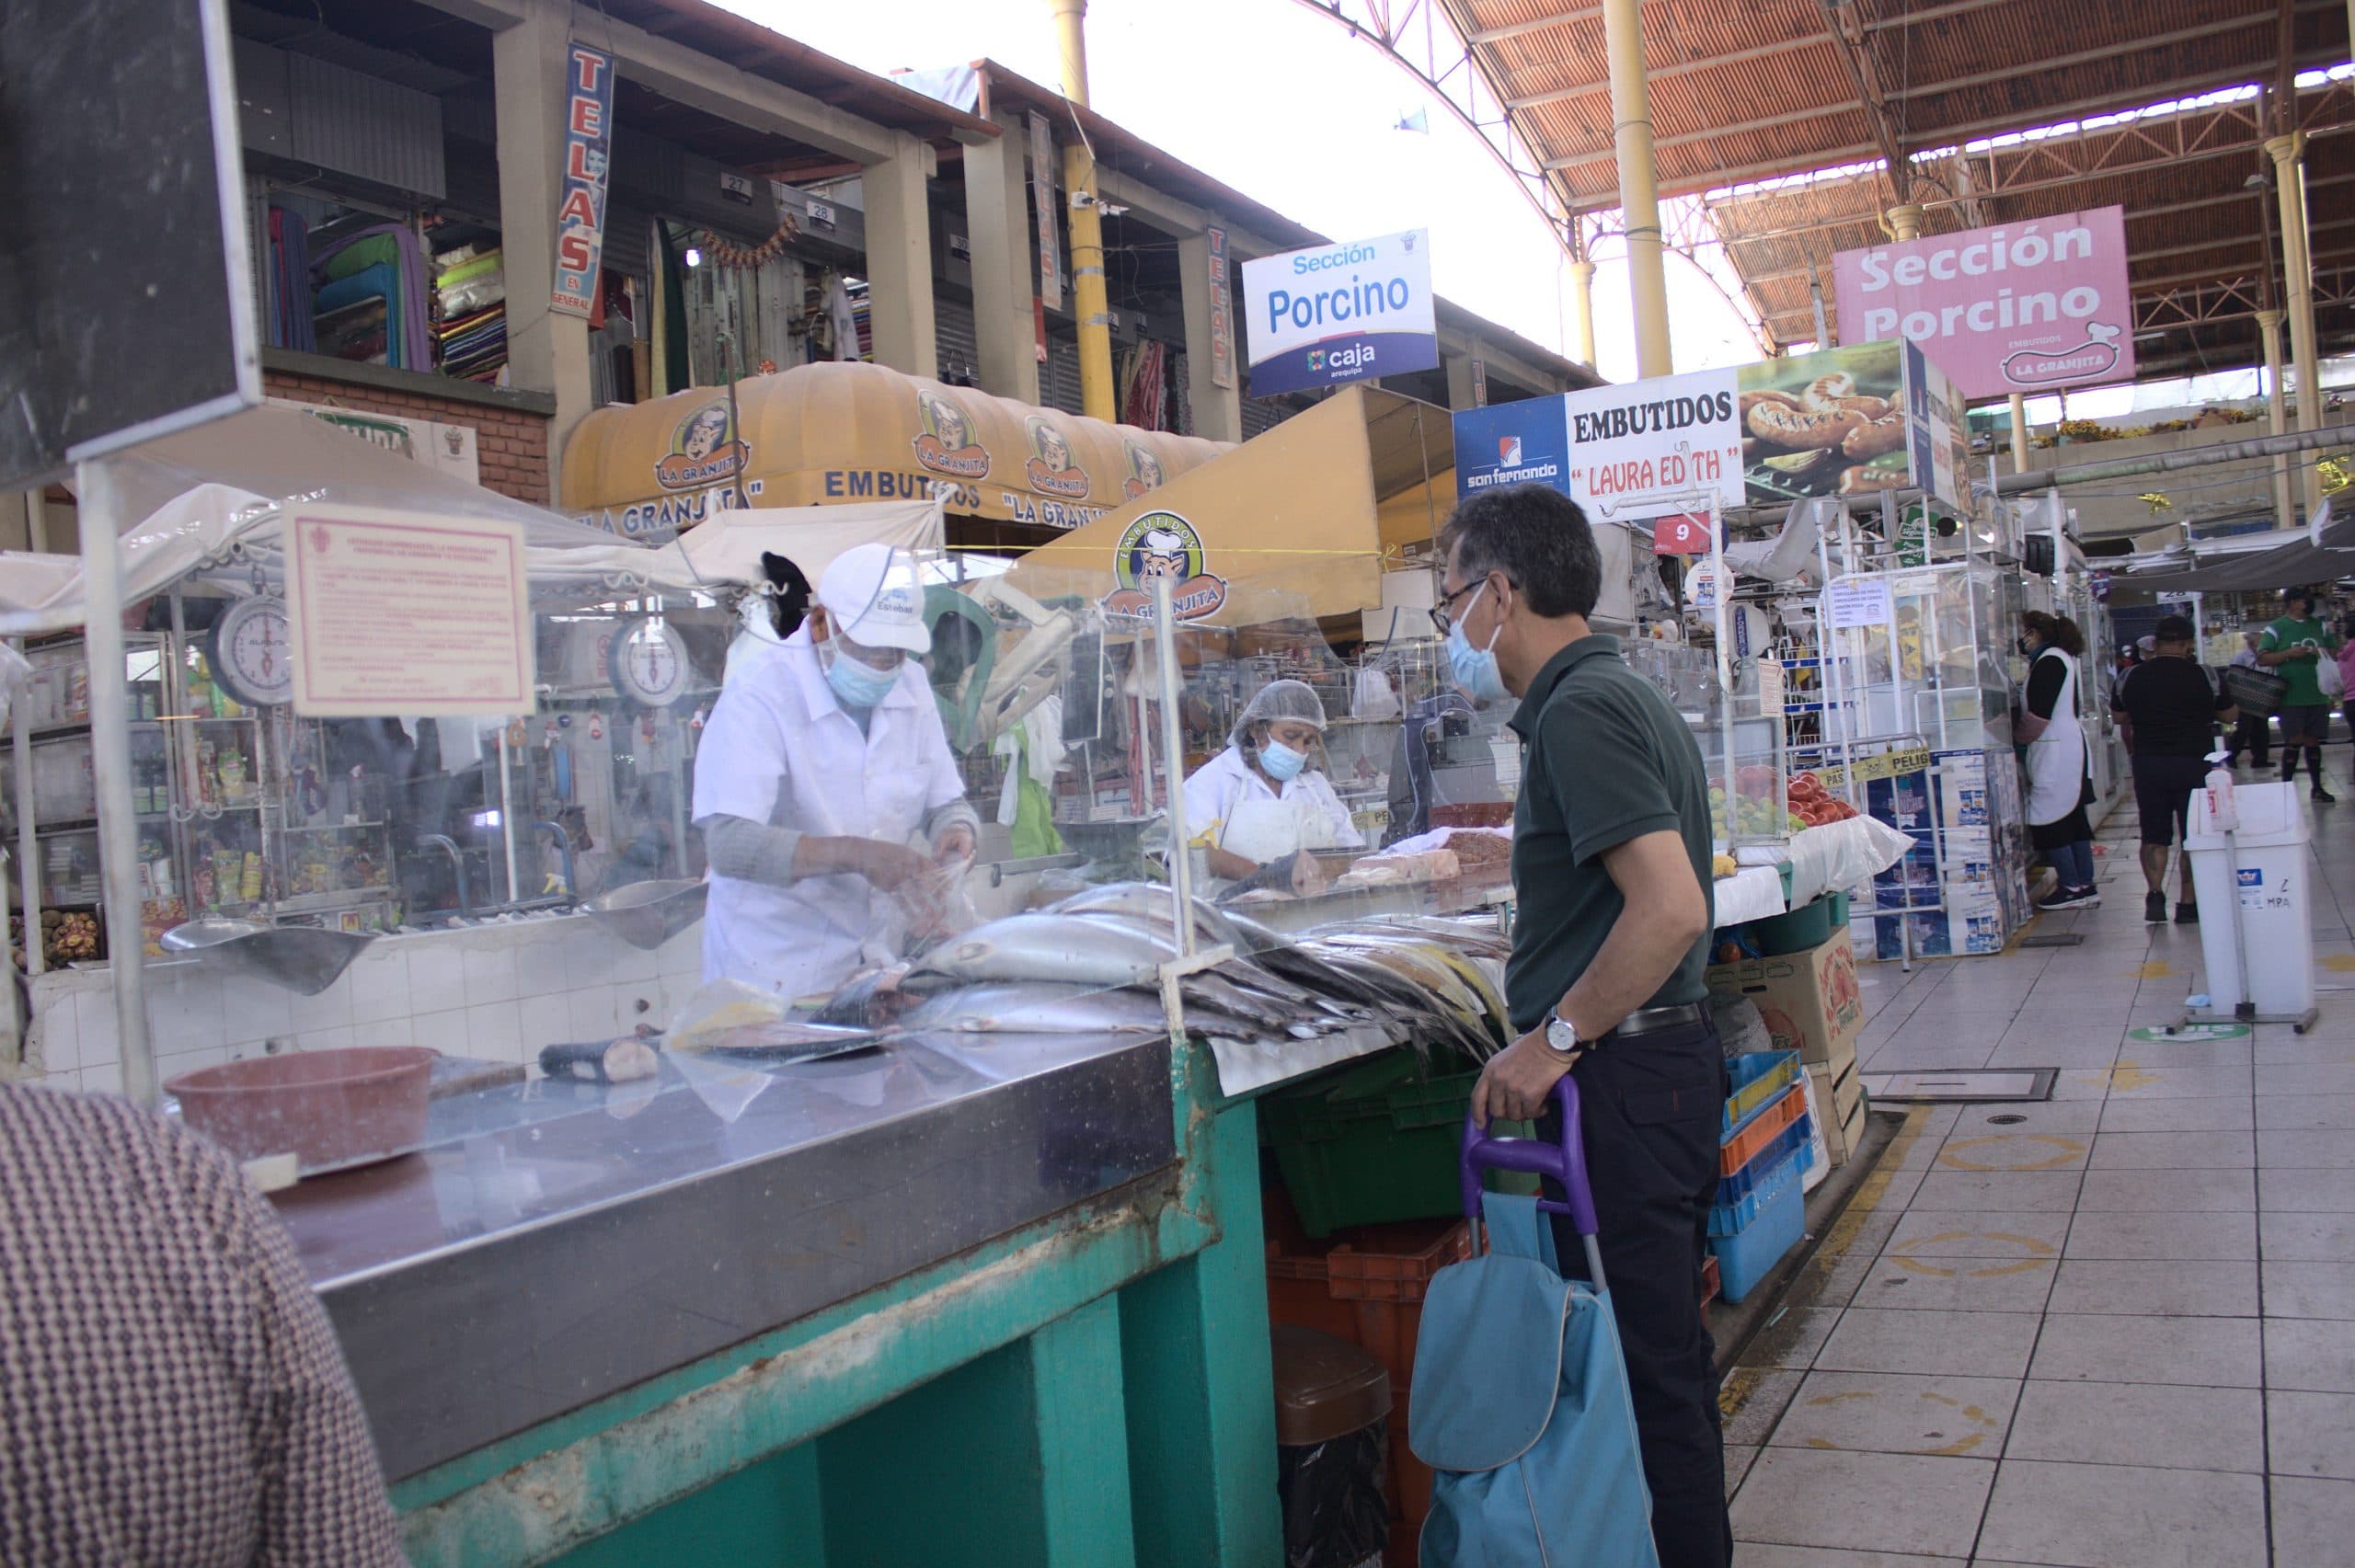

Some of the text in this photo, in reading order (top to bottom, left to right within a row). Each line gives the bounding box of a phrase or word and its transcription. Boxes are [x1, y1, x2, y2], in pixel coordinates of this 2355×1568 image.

[559, 50, 604, 273] TELAS
[729, 177, 744, 192] 27
[813, 205, 828, 220] 28
[1292, 244, 1376, 276] Sección
[1860, 224, 2092, 293] Sección
[567, 277, 580, 290] EN
[1208, 228, 1227, 362] TELAS
[552, 292, 589, 311] GENERAL
[1268, 274, 1410, 335] Porcino
[1863, 286, 2101, 343] Porcino
[1328, 342, 1376, 368] caja
[2008, 334, 2062, 349] EMBUTIDOS
[1330, 367, 1363, 379] arequipa
[2015, 354, 2105, 376] LA GRANJITA
[1573, 391, 1732, 443] EMBUTIDOS
[661, 456, 744, 481] LA GRANJIT
[919, 446, 986, 474] LA GRANJITA
[1589, 458, 1655, 497] LAURA
[1660, 449, 1721, 487] EDTH
[824, 470, 982, 509] EMBUTOS
[1120, 516, 1197, 559] EMBUTIDOS
[1676, 523, 1690, 541] 9
[1891, 752, 1929, 770] PELIG
